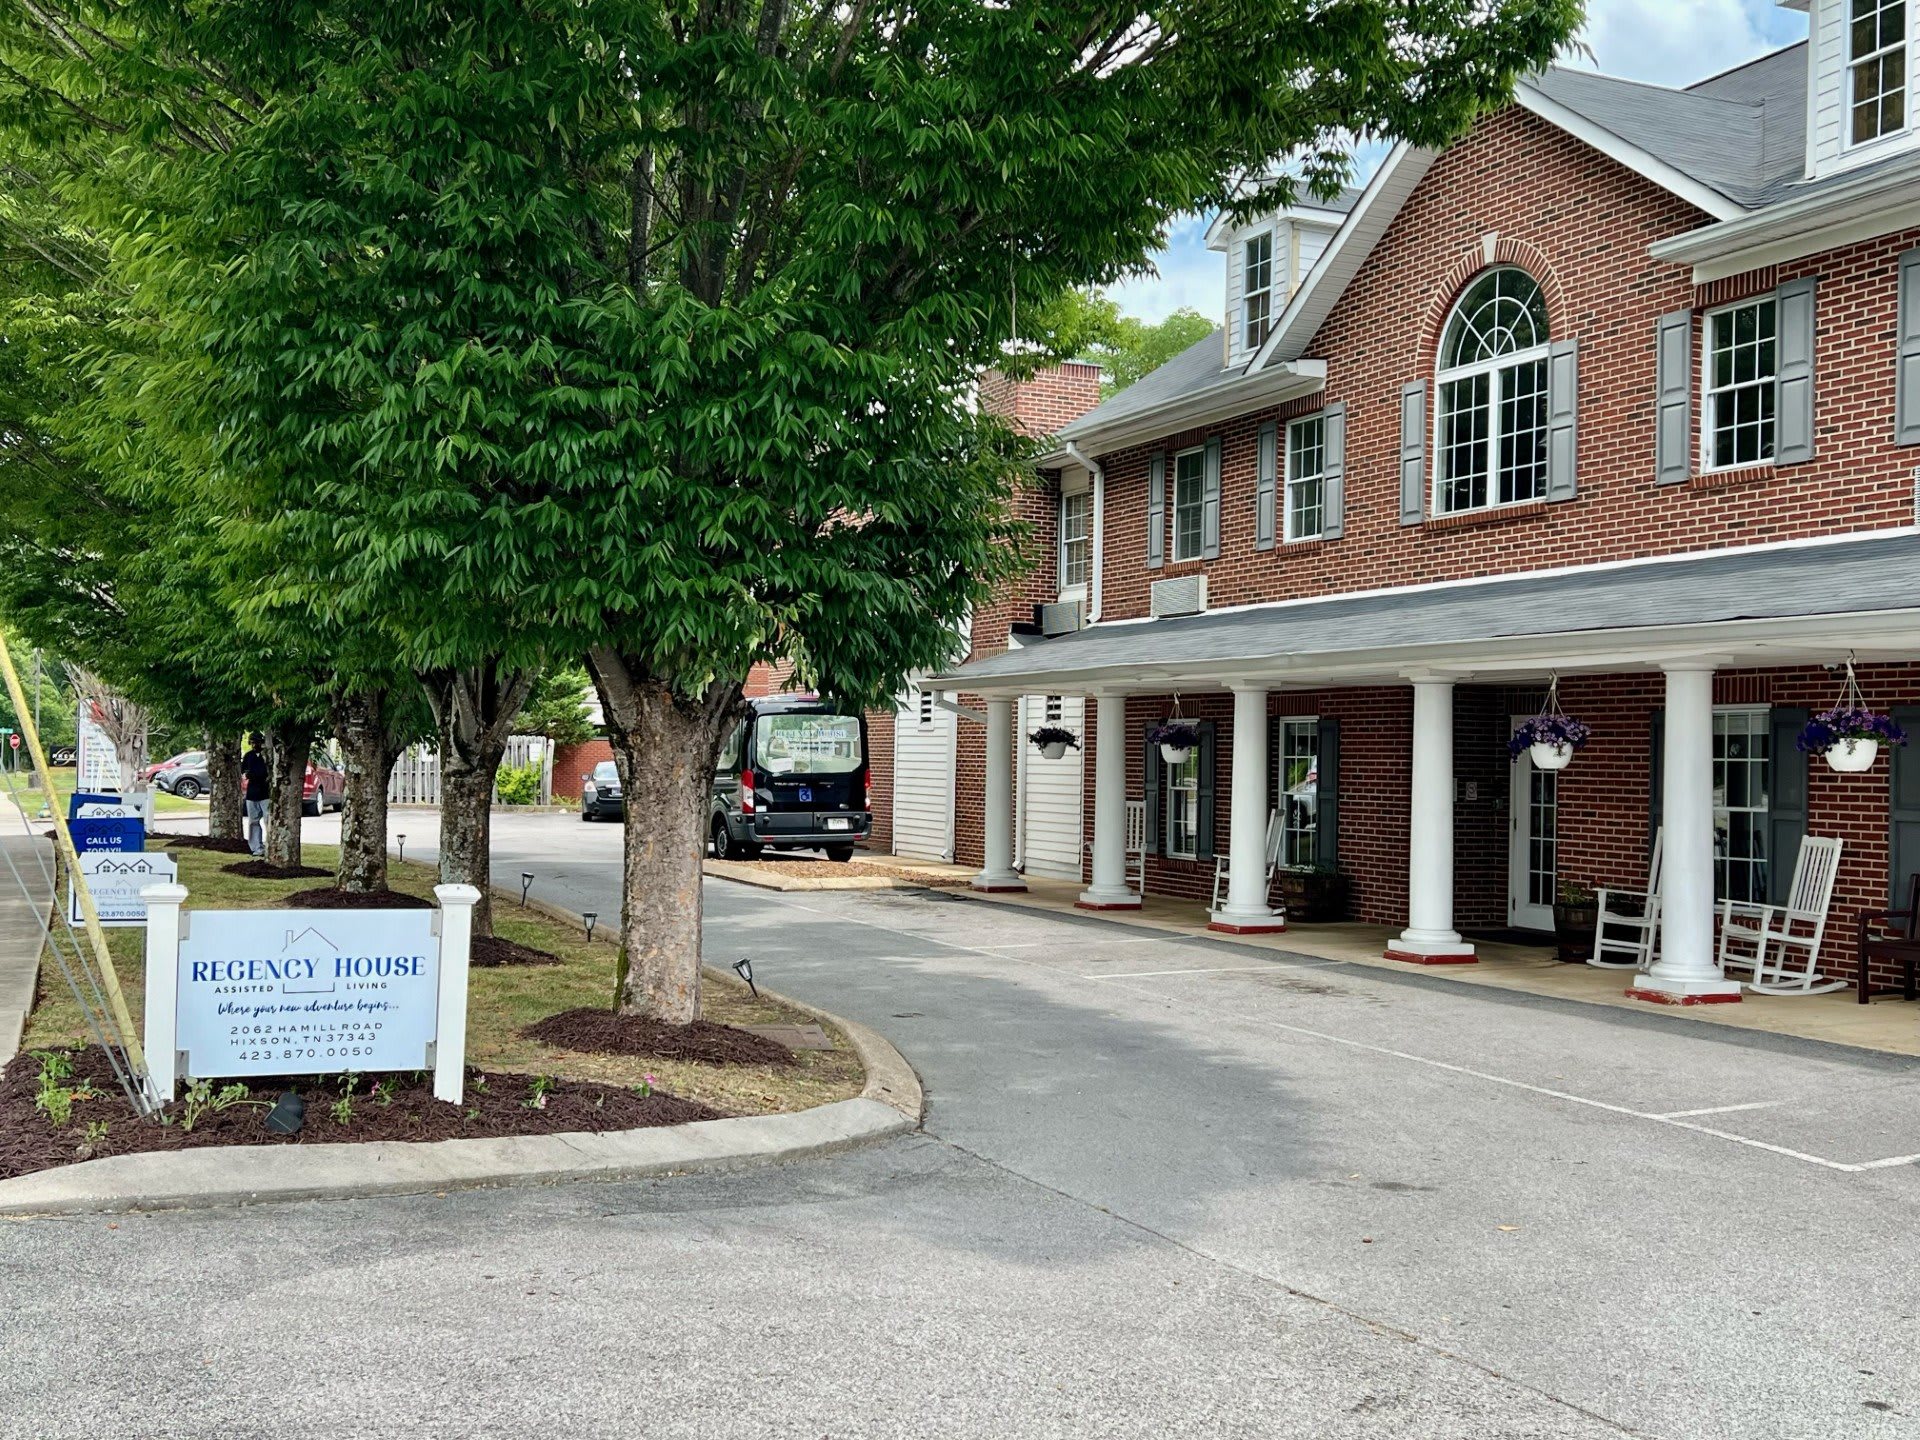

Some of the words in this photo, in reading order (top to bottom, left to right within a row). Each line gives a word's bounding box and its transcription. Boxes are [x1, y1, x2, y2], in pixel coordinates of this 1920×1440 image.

[86, 837, 108, 845] CALL
[110, 836, 122, 845] US
[192, 958, 320, 982] REGENCY
[334, 956, 426, 978] HOUSE
[214, 984, 274, 994] ASSISTED
[346, 981, 388, 990] LIVING
[217, 1001, 251, 1015] Where
[252, 1004, 277, 1018] your
[279, 1003, 301, 1013] new
[303, 999, 354, 1013] adventure
[230, 1026, 273, 1035] 2062
[278, 1024, 336, 1033] HAMILL
[341, 1022, 383, 1031] ROAD
[230, 1036, 298, 1046] HIXSON,
[303, 1035, 322, 1043] TN
[326, 1032, 376, 1043] 37343
[238, 1046, 373, 1061] 423.870.0050
